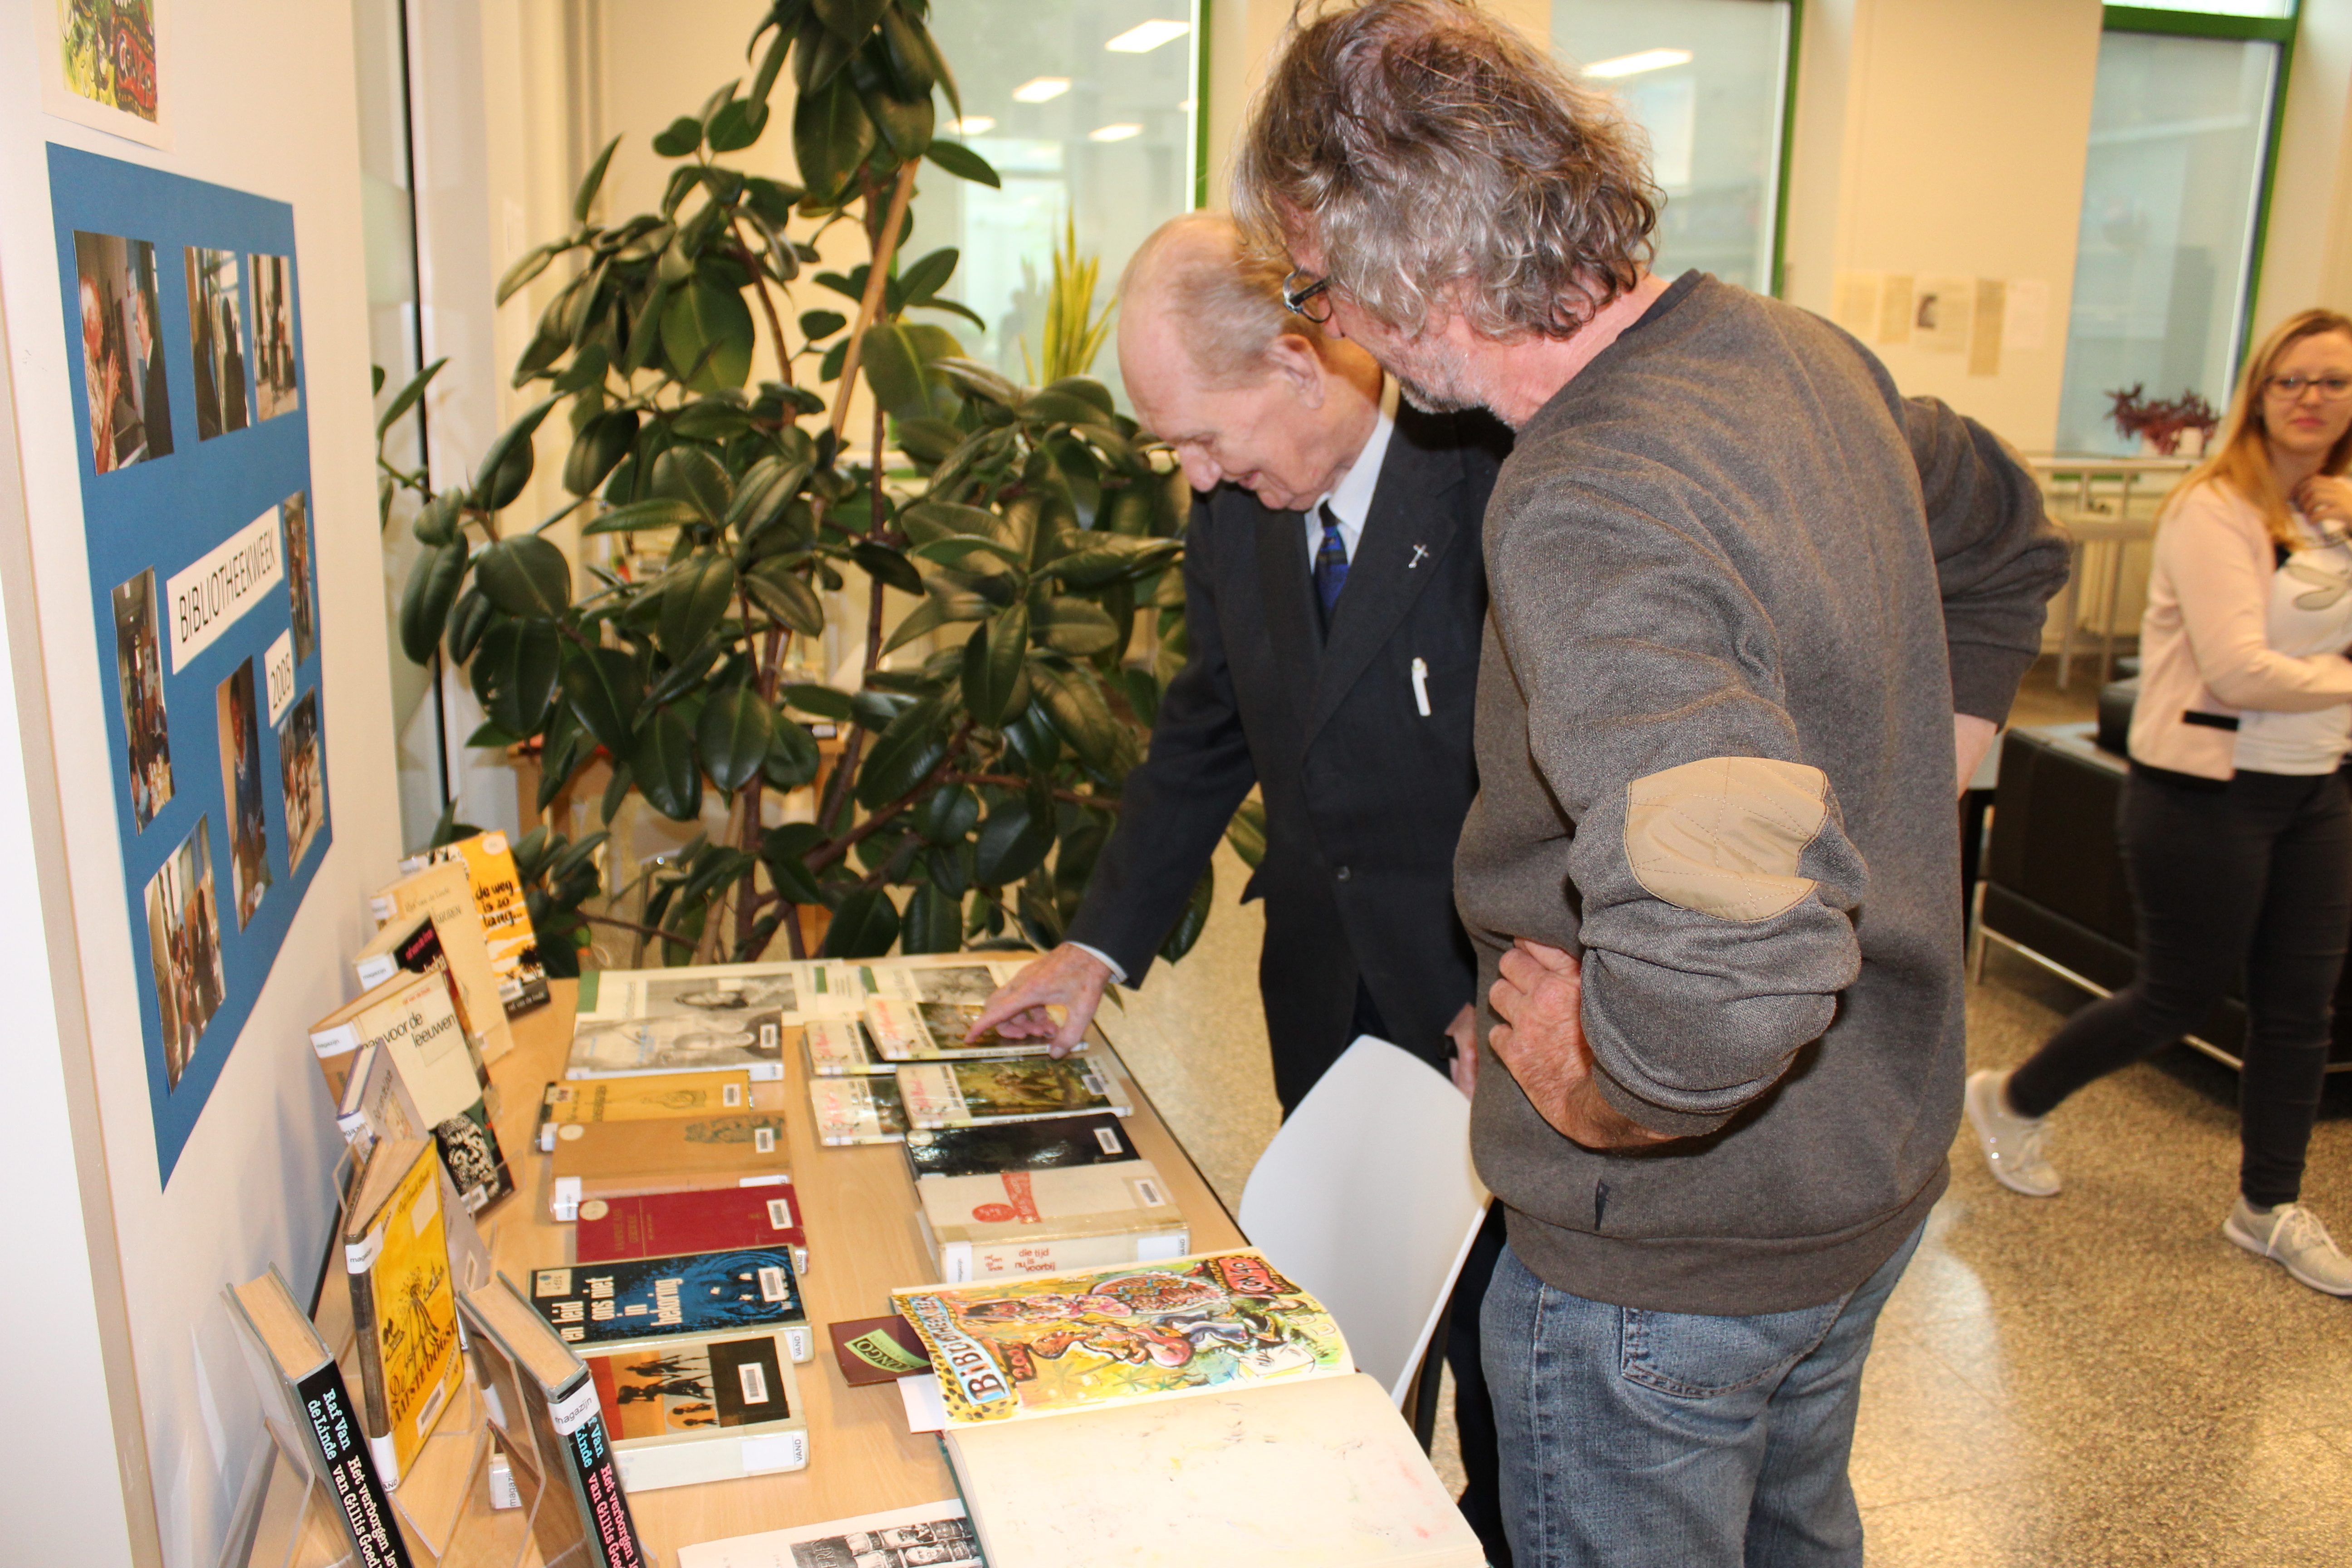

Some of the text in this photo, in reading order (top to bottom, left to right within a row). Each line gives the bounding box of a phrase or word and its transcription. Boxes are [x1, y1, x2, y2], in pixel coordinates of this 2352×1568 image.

[179, 527, 275, 644] BIBLIOTHEEKWEEK
[270, 653, 291, 710] 2005
[475, 880, 514, 901] de weg
[316, 1039, 340, 1048] magazijn
[383, 1021, 408, 1043] voor
[409, 1012, 423, 1029] de
[411, 1014, 456, 1048] leeuwen
[1019, 1248, 1049, 1258] die tijd
[1026, 1261, 1055, 1272] voorbij
[582, 1275, 615, 1321] ons niet
[616, 1303, 648, 1317] in
[647, 1277, 684, 1327] bekoring
[551, 1300, 585, 1342] en leid
[1007, 1343, 1033, 1380] 2005
[308, 1399, 337, 1460] de Linde
[323, 1387, 351, 1450] Raf Van
[555, 1396, 593, 1425] magazijn
[574, 1424, 593, 1468] Linde
[591, 1424, 605, 1458] Van
[331, 1464, 350, 1495] van
[343, 1492, 366, 1536] Gillis
[347, 1455, 366, 1485] Het
[358, 1483, 389, 1552] verborgen
[383, 1477, 398, 1490] AND
[588, 1472, 626, 1568] van Gillis Goe
[600, 1462, 614, 1493] Het
[608, 1490, 633, 1560] verborgen
